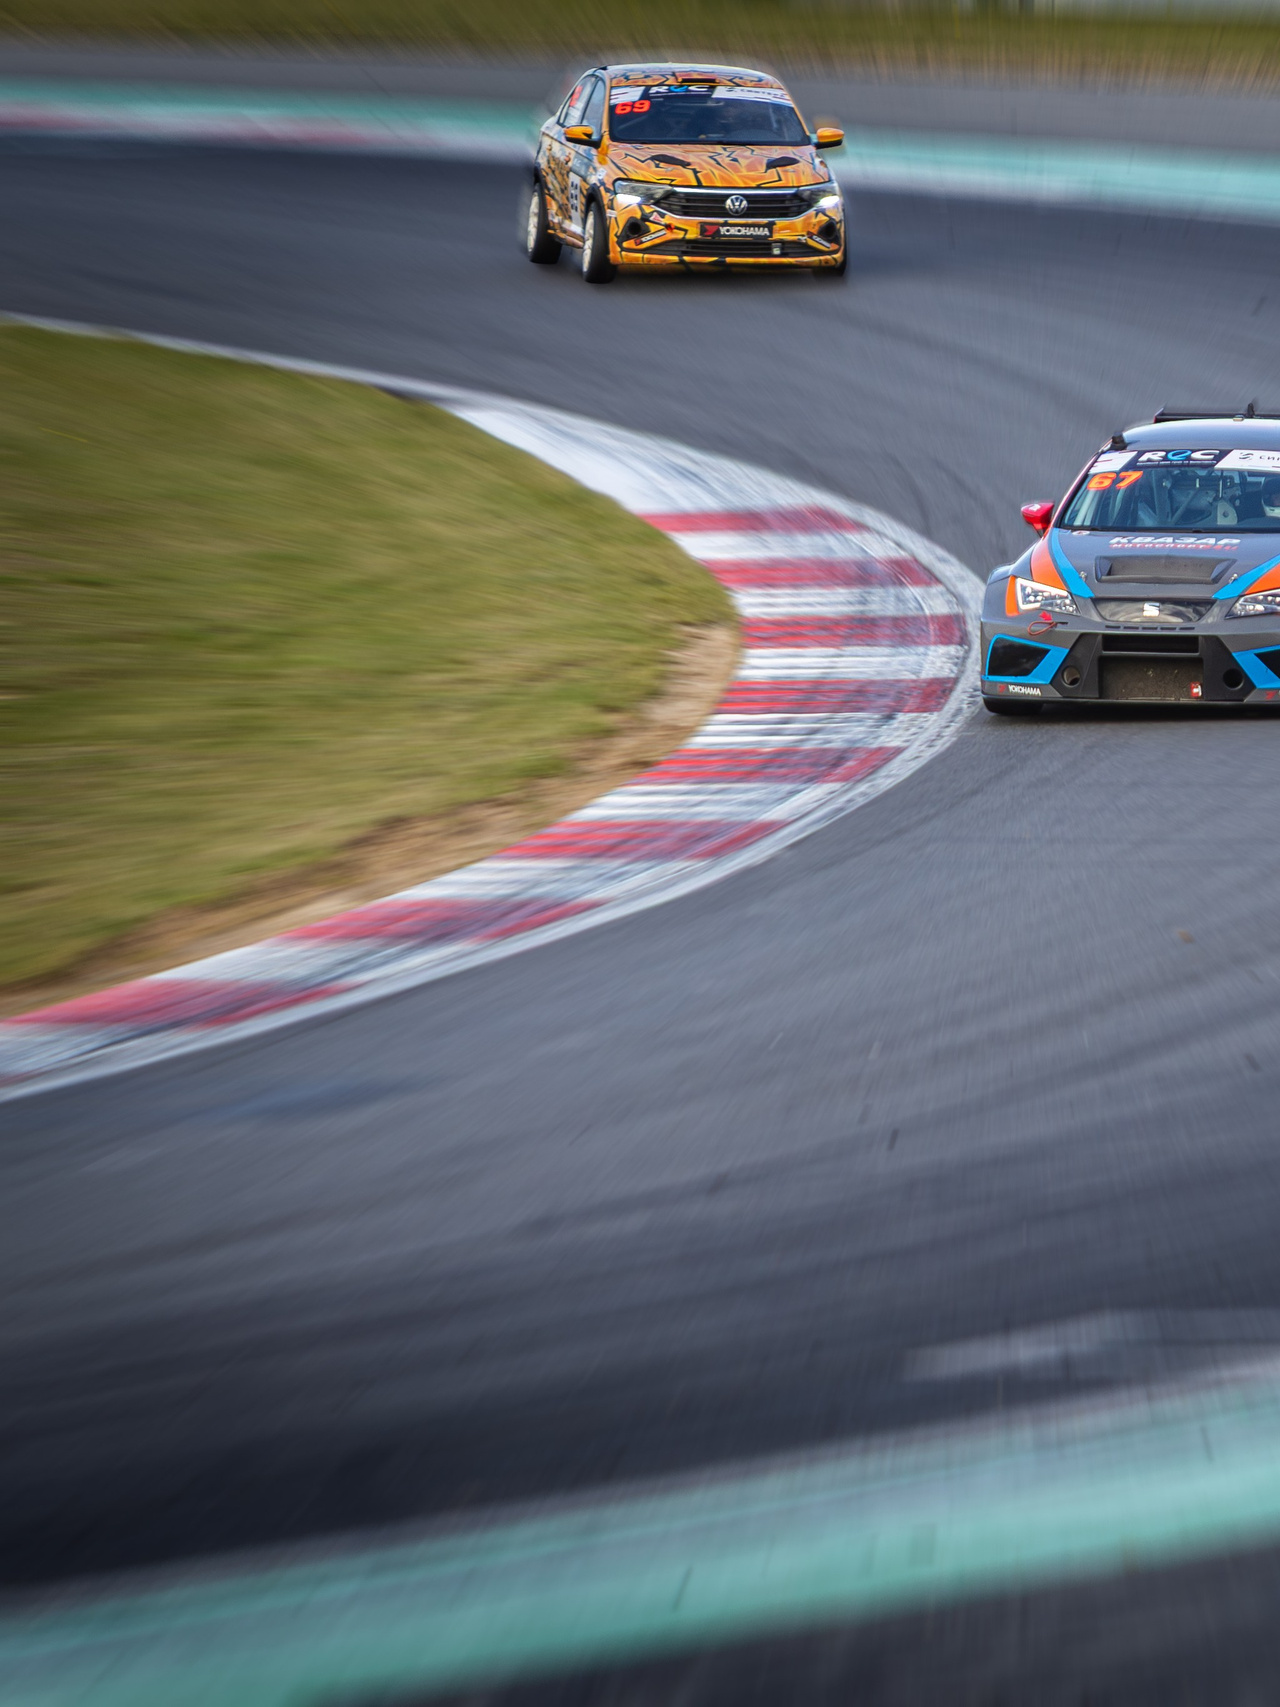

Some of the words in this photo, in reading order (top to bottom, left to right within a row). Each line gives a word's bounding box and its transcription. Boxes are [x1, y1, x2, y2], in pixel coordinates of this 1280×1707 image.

[615, 100, 651, 115] 69
[719, 226, 770, 236] YOKOHAMA
[1087, 471, 1143, 490] 67
[1109, 536, 1241, 545] КВАЗАР
[1008, 684, 1041, 696] YOKOHAMA
